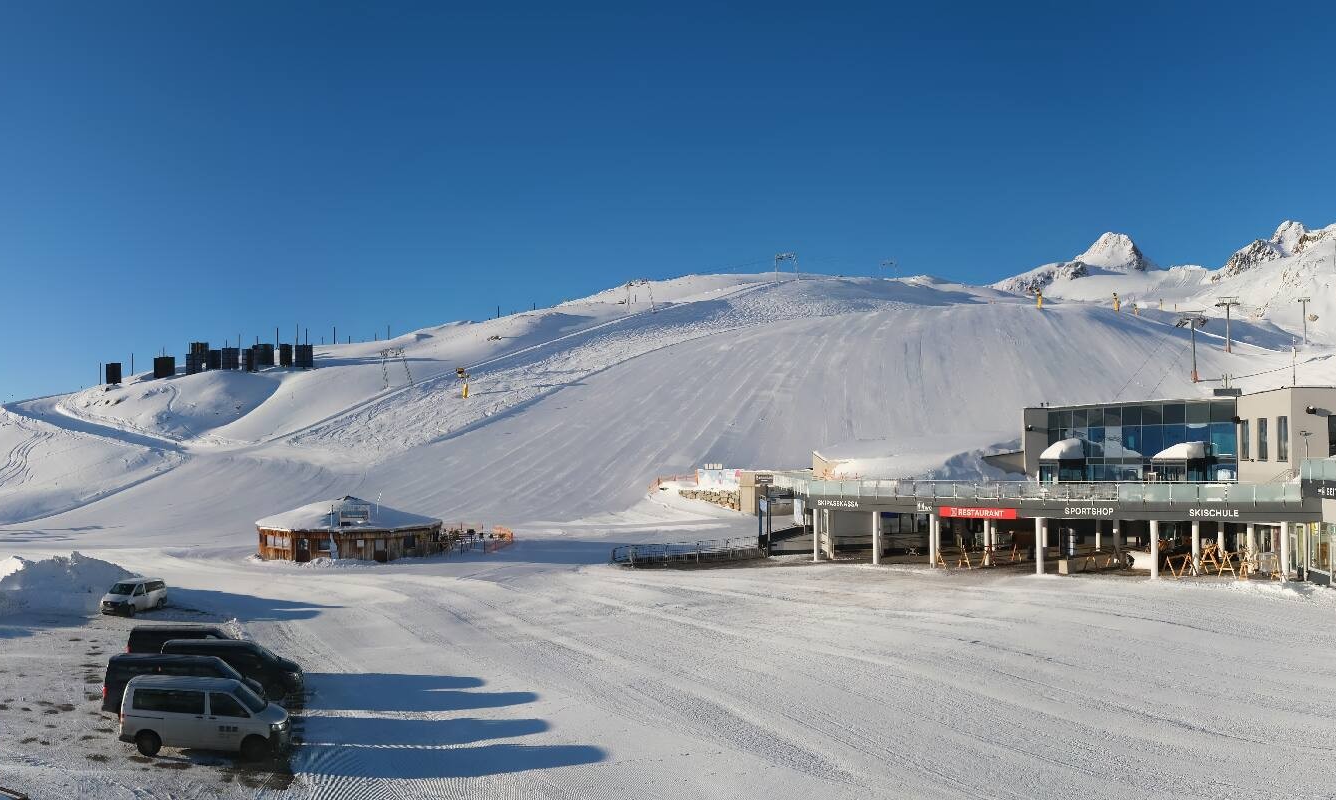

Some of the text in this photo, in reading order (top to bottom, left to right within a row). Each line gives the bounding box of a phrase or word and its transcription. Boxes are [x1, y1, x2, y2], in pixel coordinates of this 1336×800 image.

[957, 509, 1004, 518] RESTAURANT
[1064, 507, 1114, 517] SPORTSHOP
[1189, 508, 1240, 518] SKISCHULE
